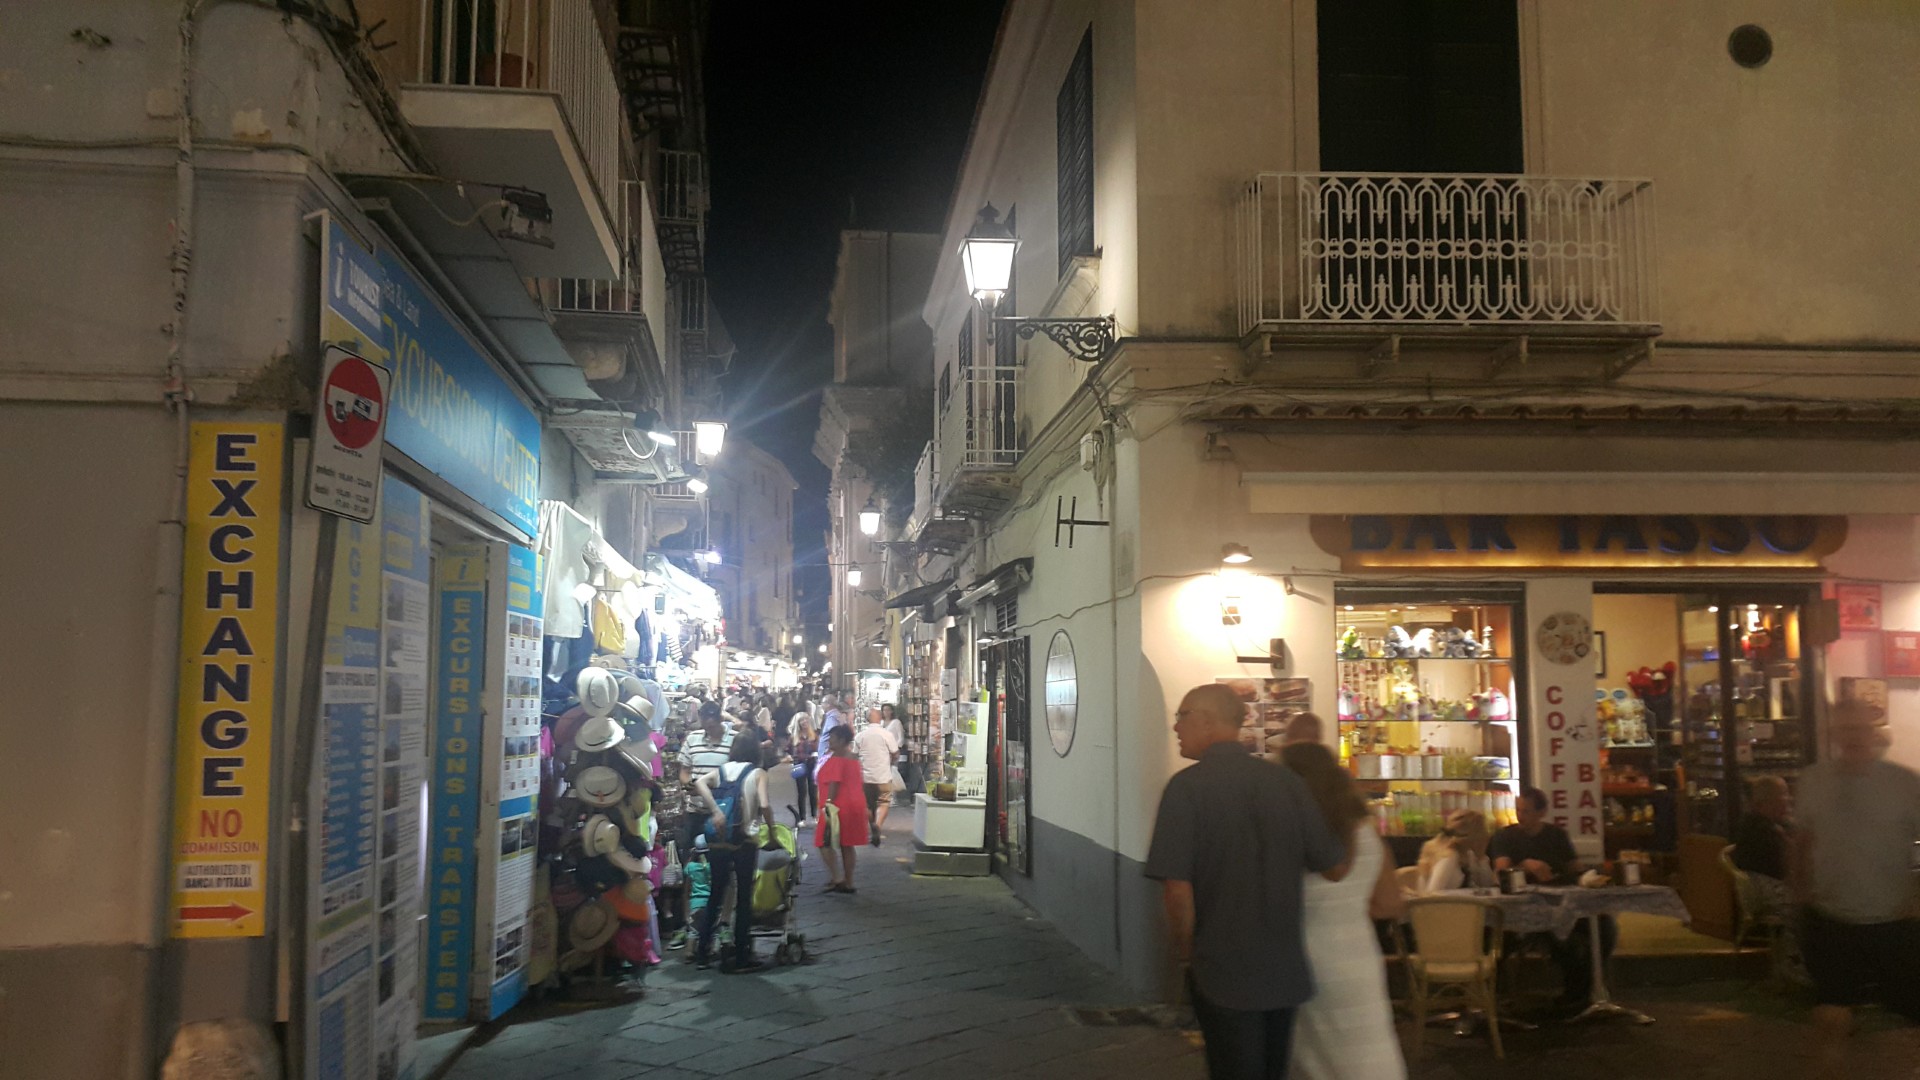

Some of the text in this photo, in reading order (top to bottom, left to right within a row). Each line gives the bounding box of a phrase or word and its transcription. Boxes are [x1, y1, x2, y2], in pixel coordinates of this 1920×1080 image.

[201, 434, 257, 796] EXCHANGE
[446, 598, 472, 795] EXCURSIONS
[181, 841, 259, 854] COMMISSION
[200, 808, 242, 838] NO
[1577, 763, 1599, 834] BAR
[435, 827, 464, 1009] TRANSFERS
